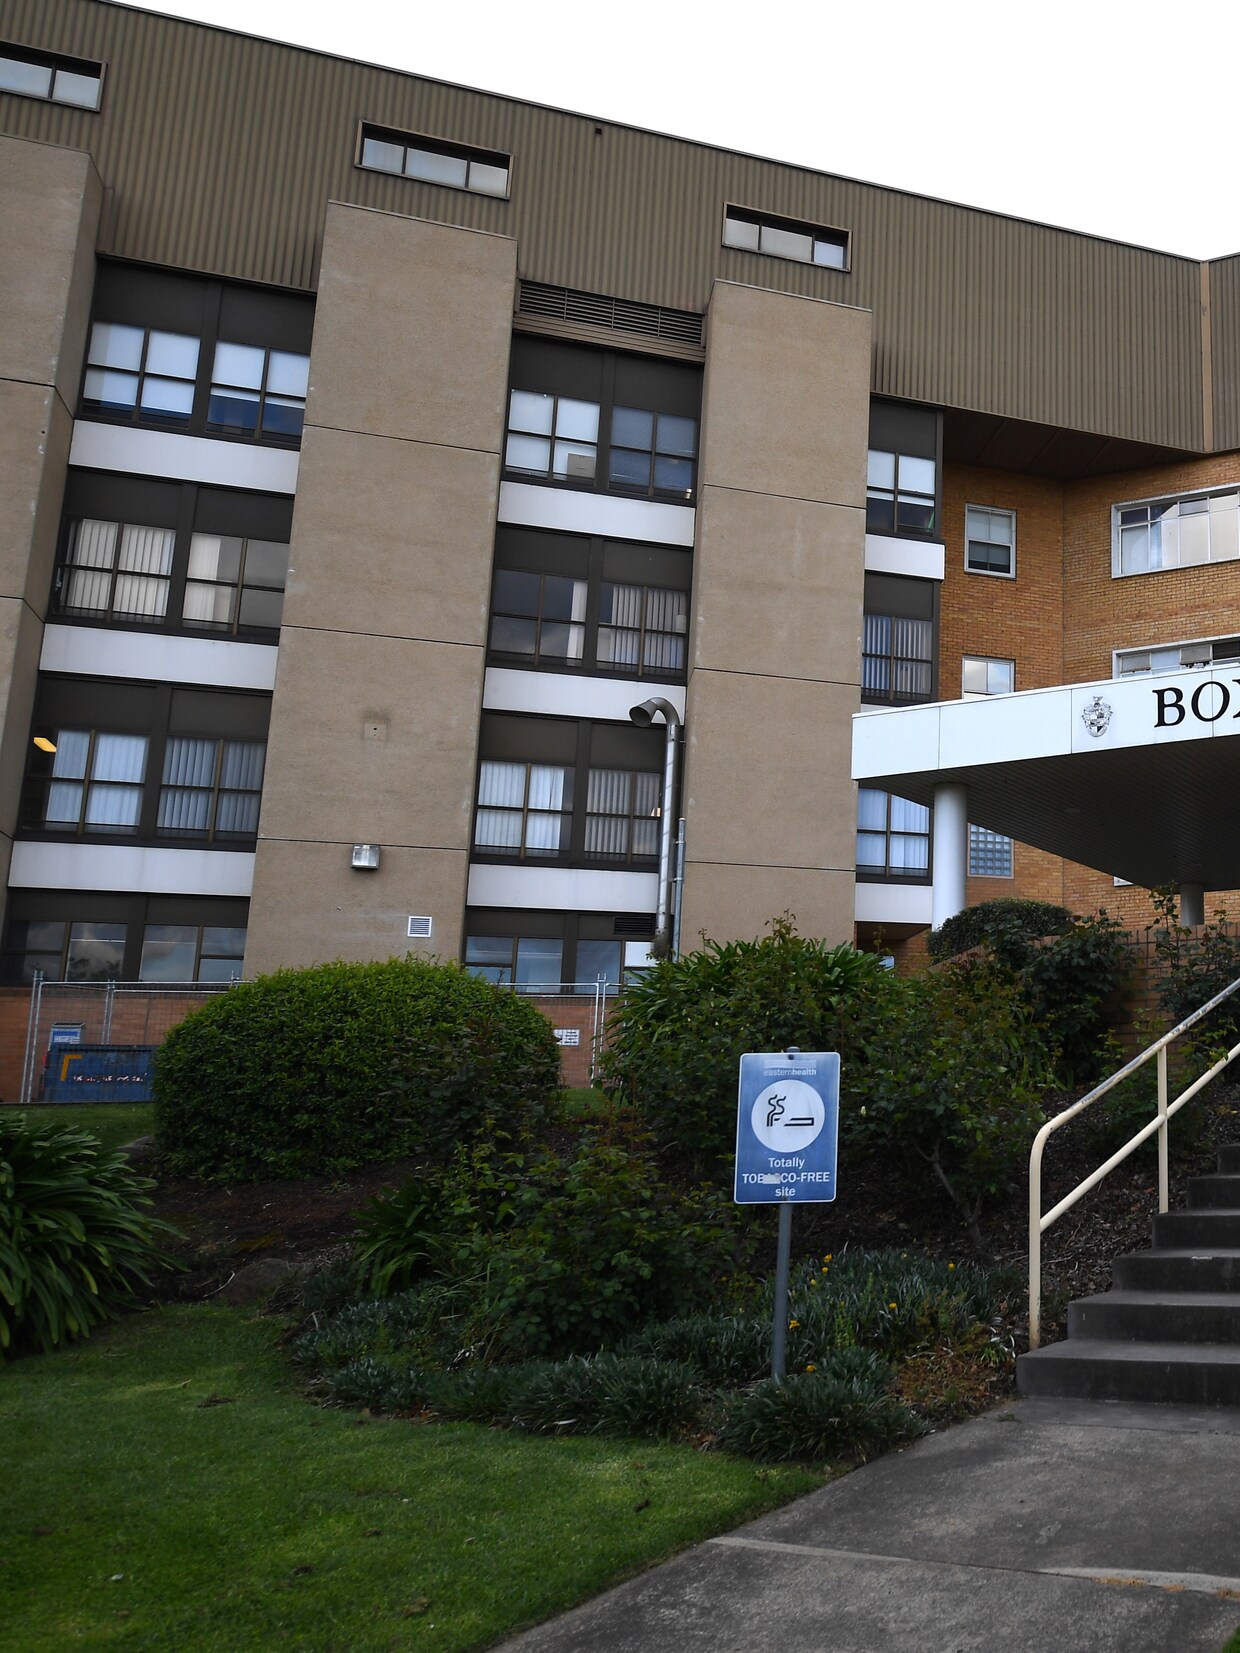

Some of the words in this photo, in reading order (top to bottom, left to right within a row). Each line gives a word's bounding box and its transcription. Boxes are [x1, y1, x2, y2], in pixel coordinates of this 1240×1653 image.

[768, 1157, 805, 1170] Totally
[742, 1171, 830, 1184] TOBCO-FREE
[775, 1186, 796, 1197] site
